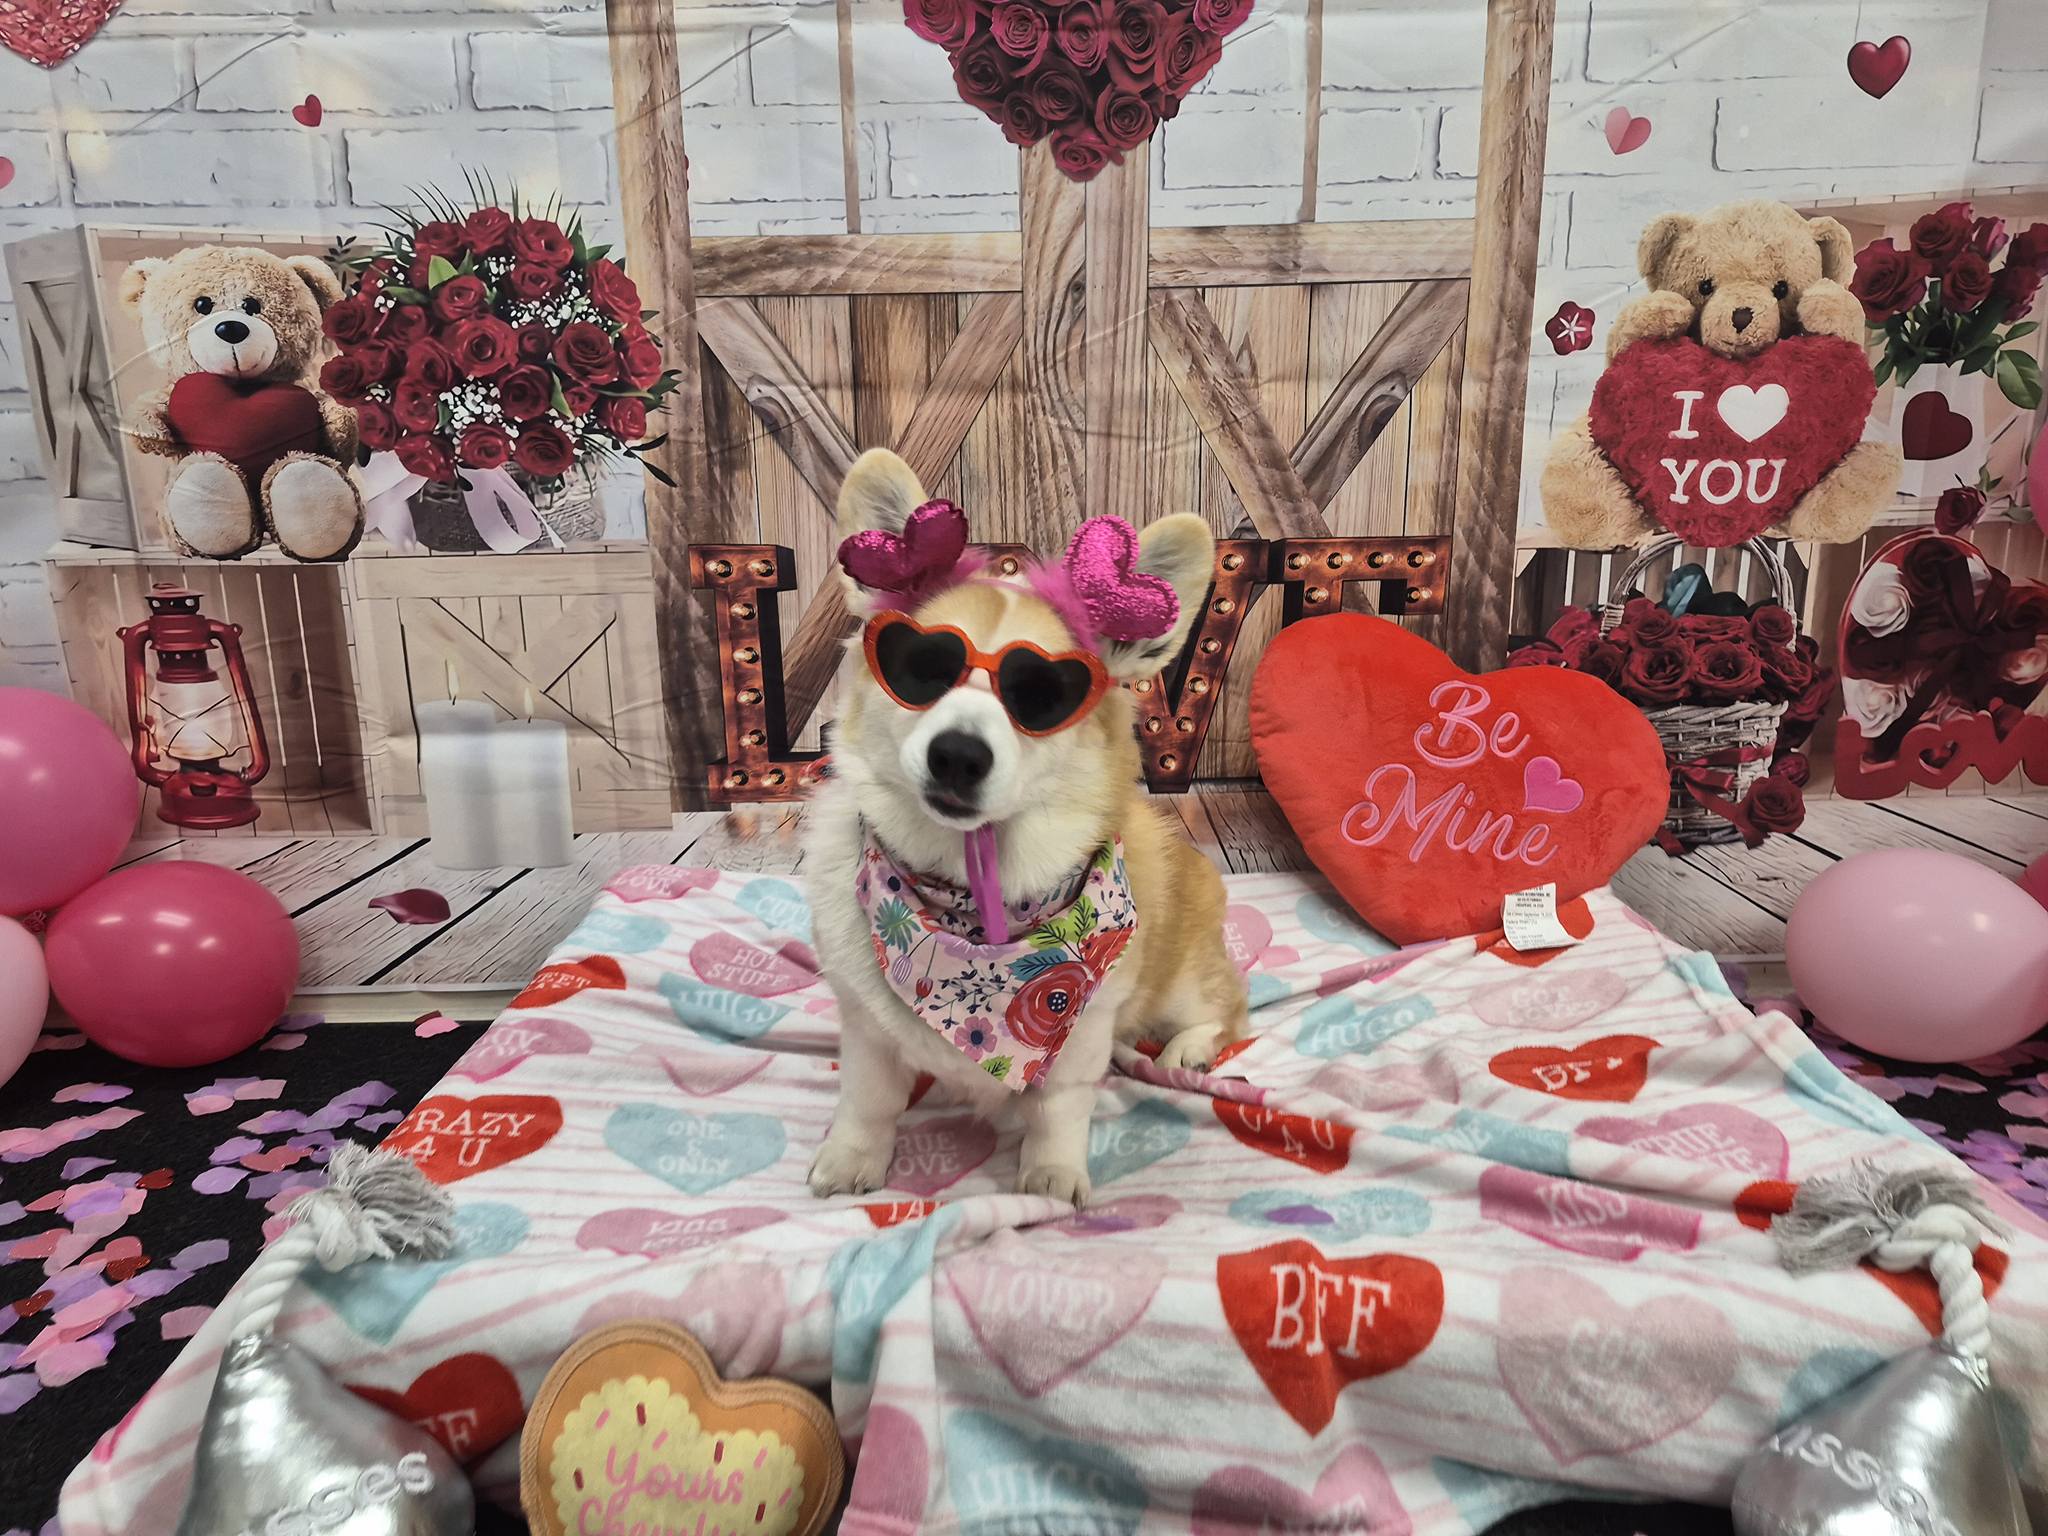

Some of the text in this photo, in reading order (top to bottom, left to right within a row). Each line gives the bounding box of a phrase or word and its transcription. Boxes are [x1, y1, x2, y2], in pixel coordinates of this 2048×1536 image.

[1668, 389, 1705, 440] I
[1660, 458, 1784, 505] YOU
[1413, 679, 1531, 769] Be
[1340, 762, 1559, 867] Mine
[706, 962, 791, 987] STUFF
[733, 948, 785, 971] HOT
[666, 1120, 725, 1141] ONE
[896, 1131, 957, 1152] RUE
[1088, 1124, 1170, 1157] UGS
[410, 1134, 492, 1168] 4 U
[658, 1154, 730, 1174] ONLY
[894, 1153, 960, 1177] OVE
[1537, 1180, 1629, 1229] KISS
[1266, 1261, 1392, 1359] BFF
[605, 1444, 745, 1513] Yours
